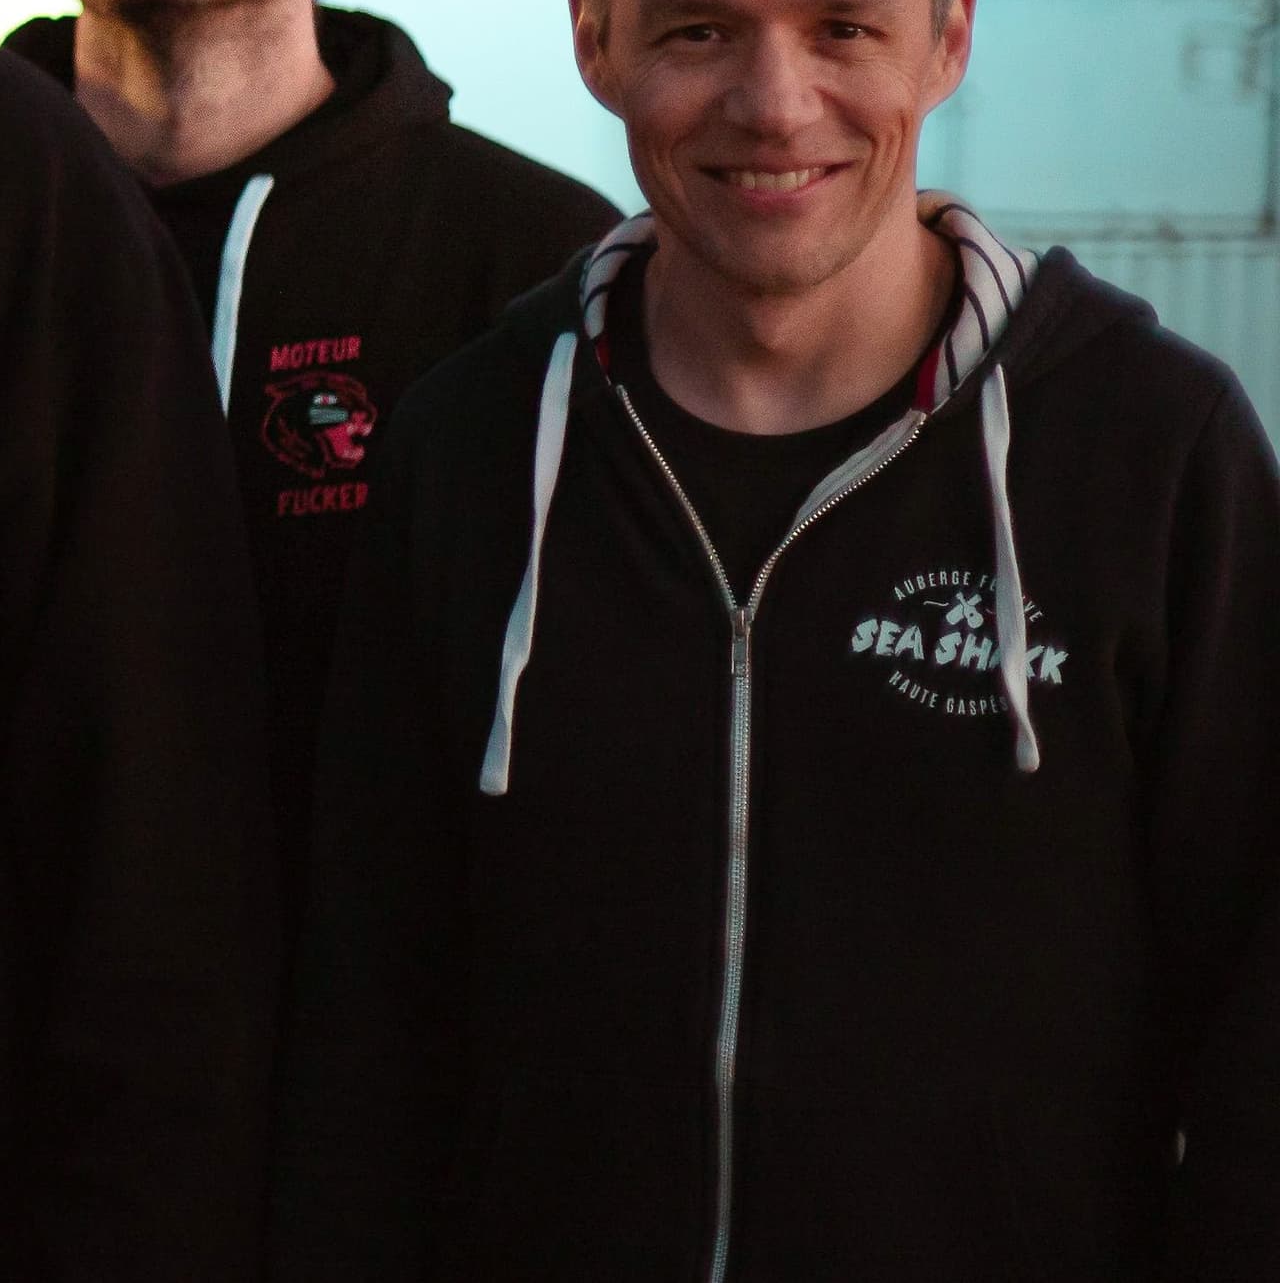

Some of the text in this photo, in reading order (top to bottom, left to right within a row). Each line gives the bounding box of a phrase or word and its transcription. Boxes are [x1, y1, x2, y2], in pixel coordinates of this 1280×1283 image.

[271, 335, 361, 371] MOTEUR
[277, 481, 369, 517] FUCKER
[893, 570, 972, 601] AUBERGE
[851, 618, 925, 661] SEA
[888, 670, 940, 708] HAUTE
